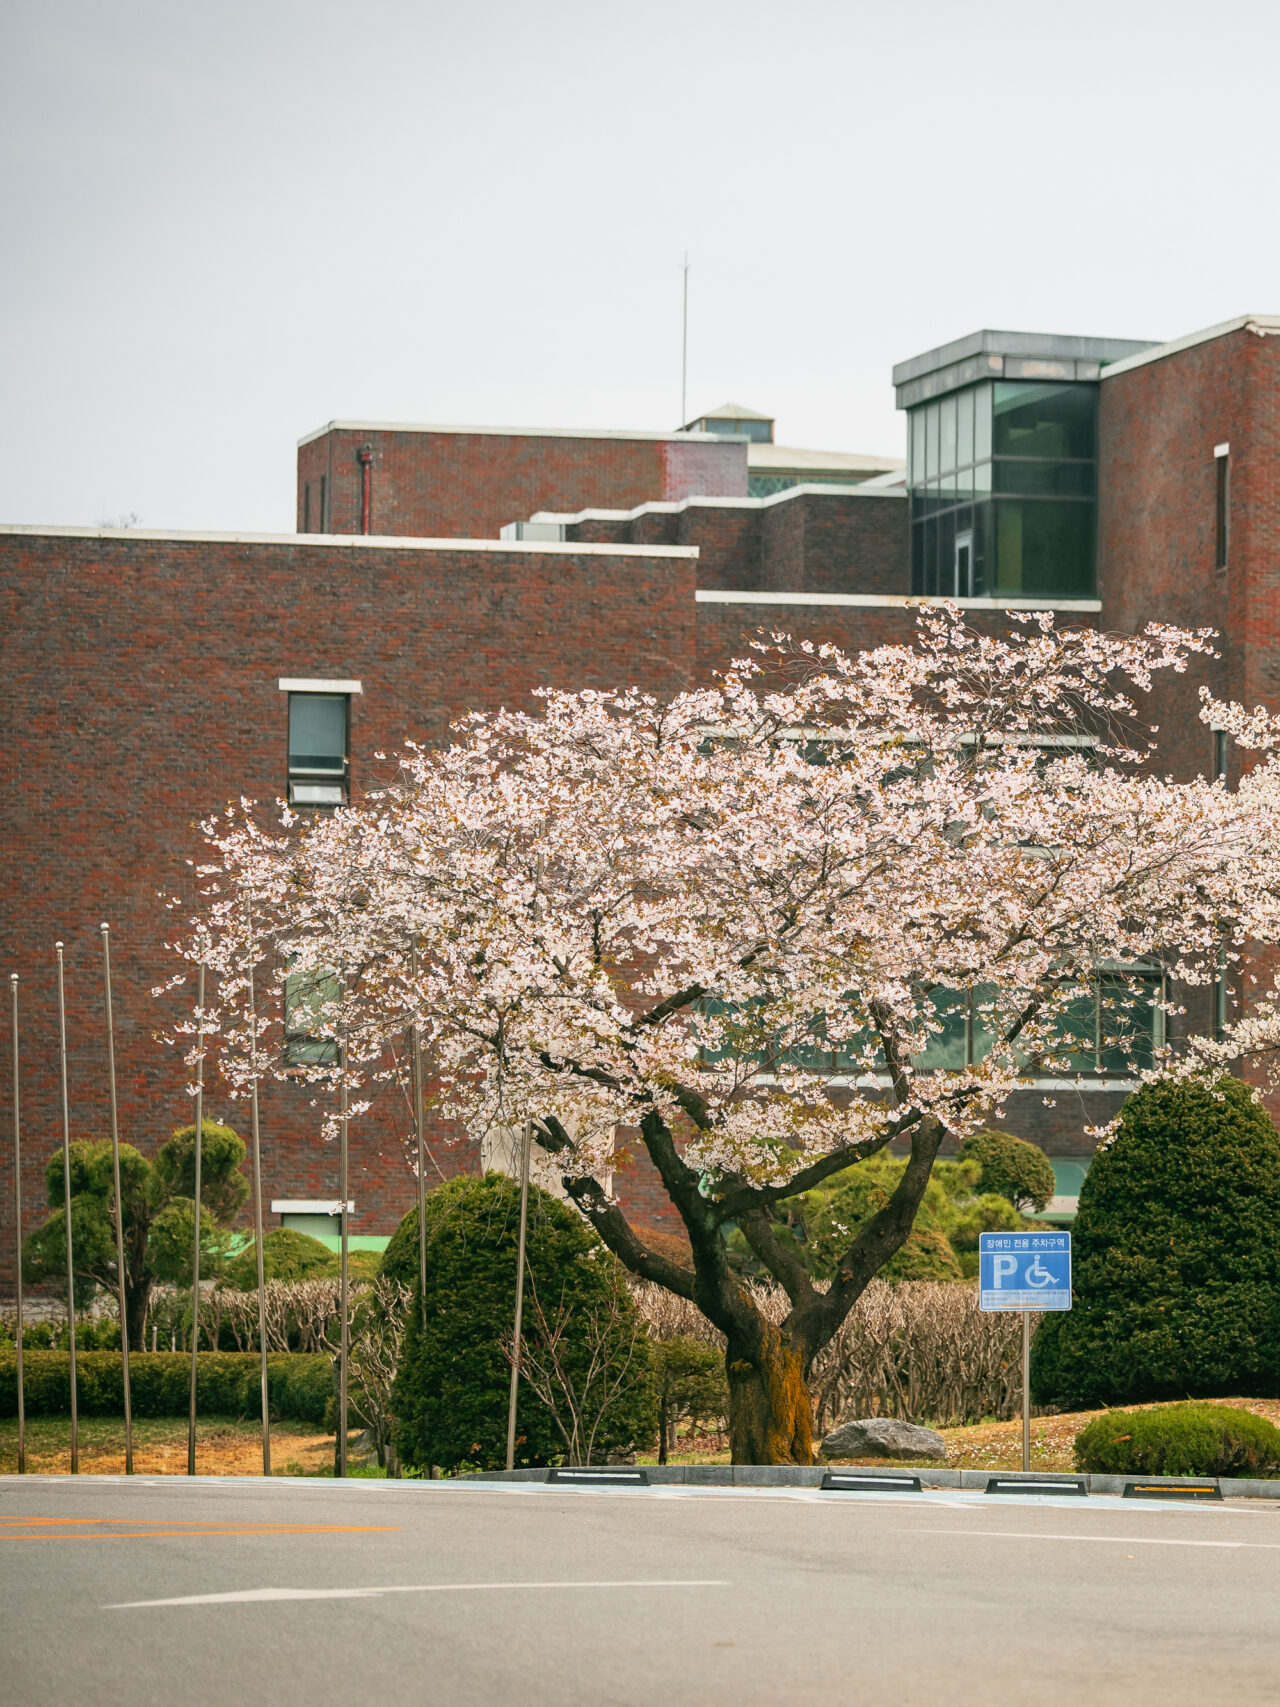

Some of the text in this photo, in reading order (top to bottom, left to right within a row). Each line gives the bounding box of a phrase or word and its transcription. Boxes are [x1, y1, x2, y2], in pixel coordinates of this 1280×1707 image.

[986, 1237, 1065, 1248] 장애인 전용 주차구역
[993, 1254, 1018, 1288] P
